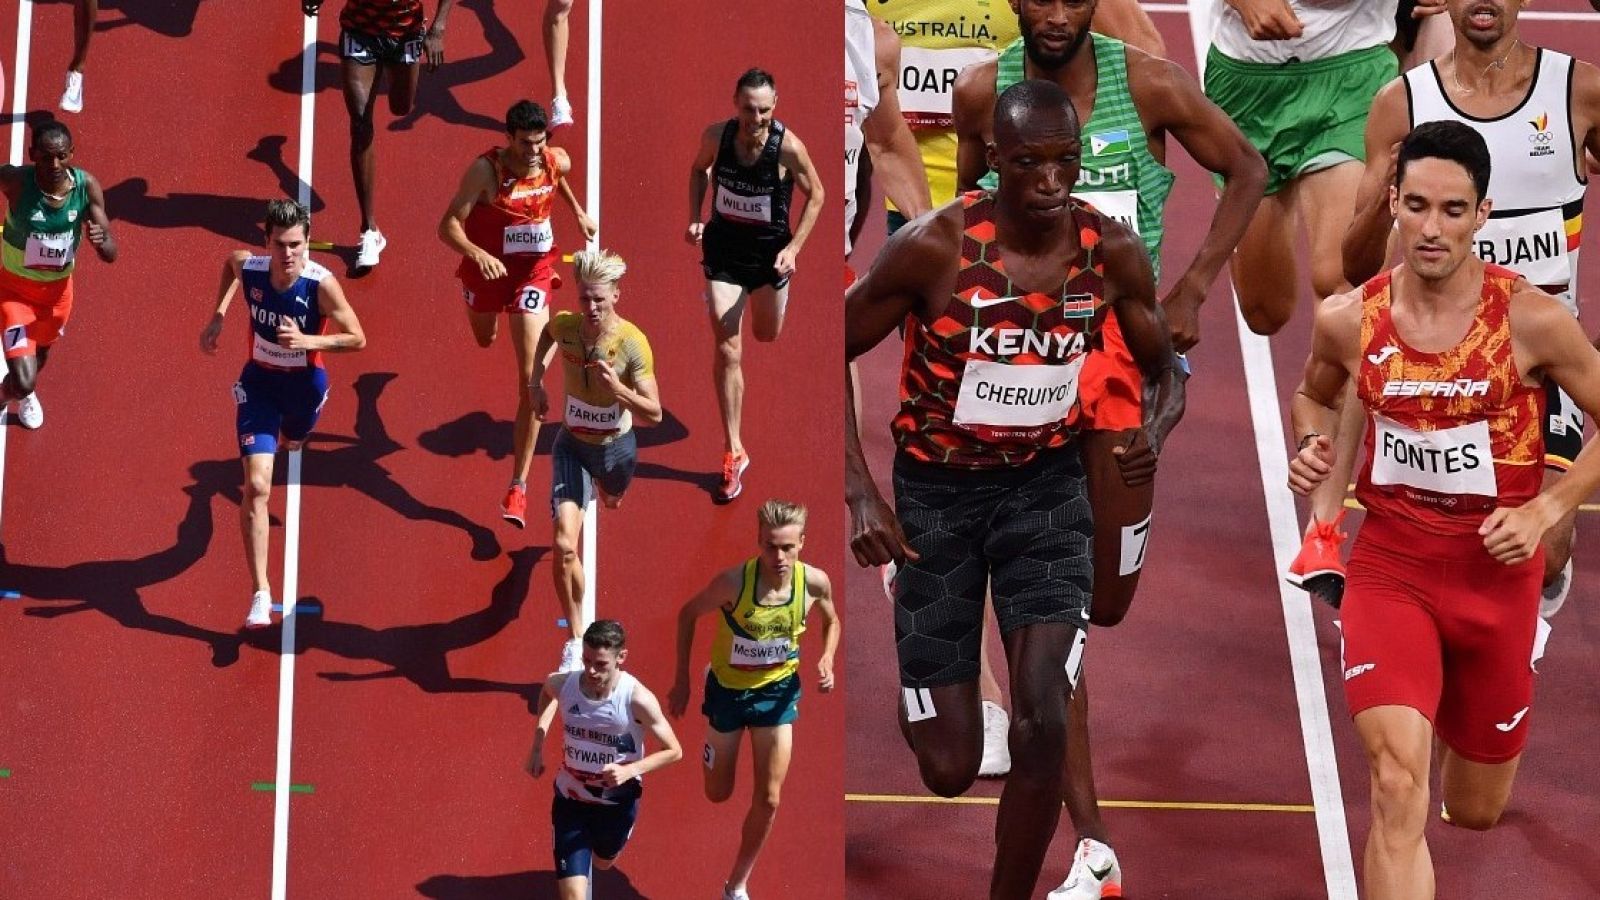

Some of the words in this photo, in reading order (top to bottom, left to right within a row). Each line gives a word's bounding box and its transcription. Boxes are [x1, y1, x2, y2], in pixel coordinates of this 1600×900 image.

[886, 20, 990, 40] USTRALIA
[723, 195, 762, 213] WILLIS
[1472, 231, 1560, 265] BJANI
[525, 290, 540, 309] 8
[7, 327, 20, 347] 7
[969, 327, 1085, 358] KENYA
[1382, 379, 1491, 397] ESPAÑA
[569, 404, 616, 423] FARKEN
[1383, 431, 1480, 474] FONTES
[734, 643, 789, 658] McSWEYN
